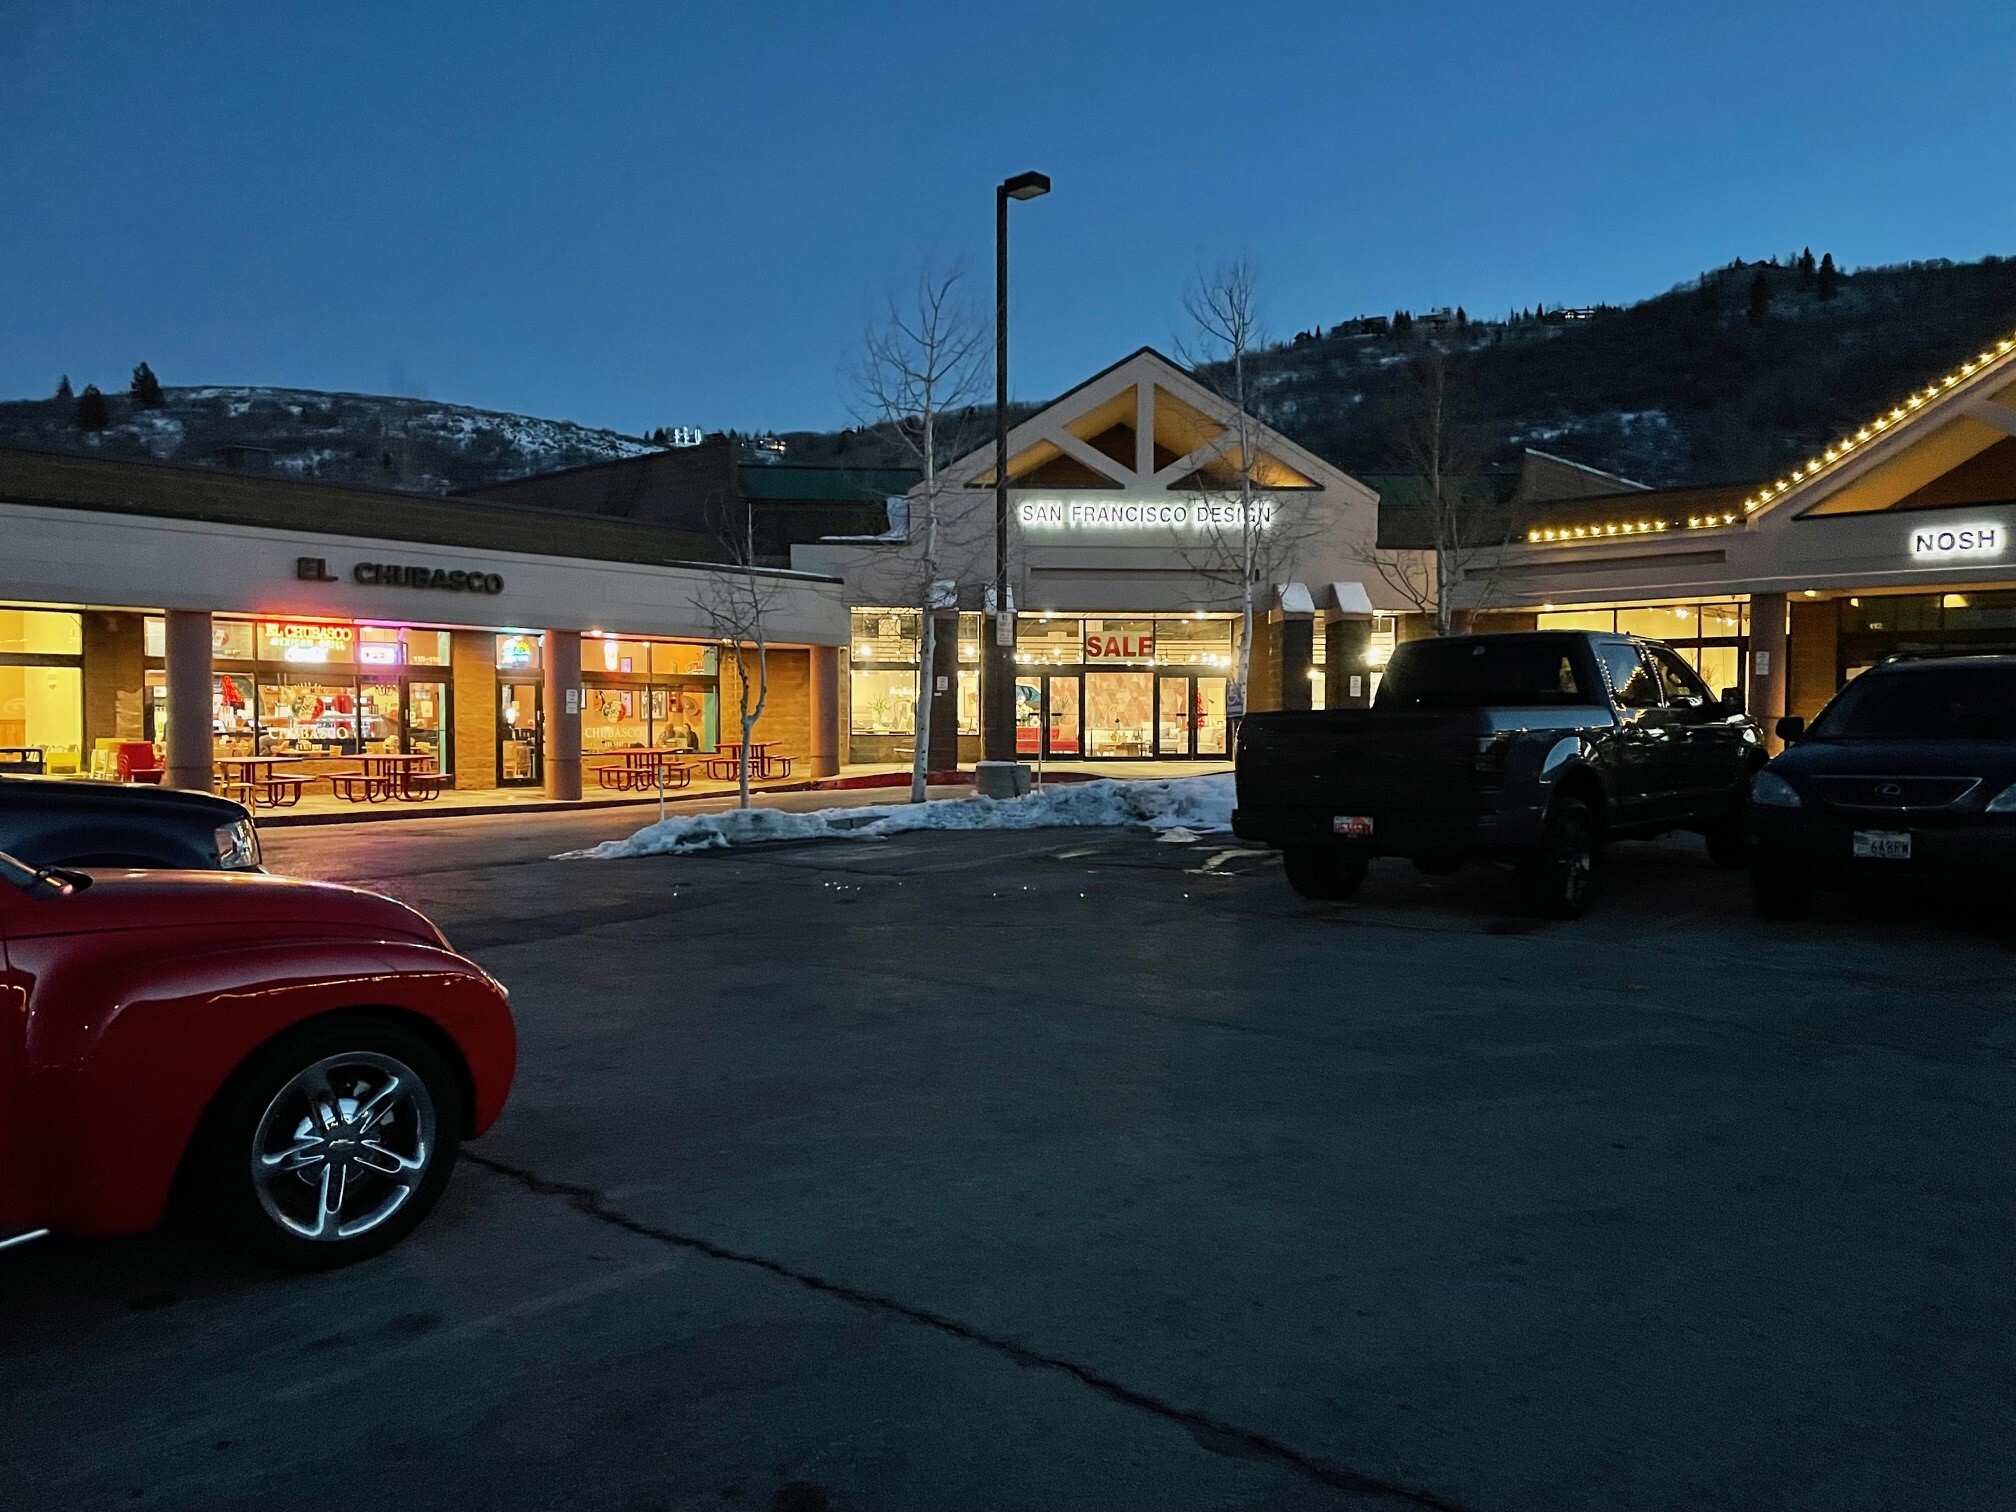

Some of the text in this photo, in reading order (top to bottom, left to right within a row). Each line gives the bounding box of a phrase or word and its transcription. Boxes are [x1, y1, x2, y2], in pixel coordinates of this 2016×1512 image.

[1022, 505, 1271, 524] SAN FRANCISCO DESIGN
[1916, 529, 1995, 552] NOSH
[297, 556, 505, 595] EL CHUBASCO
[265, 623, 353, 642] EL CHUBASCO
[1086, 636, 1155, 657] SALE
